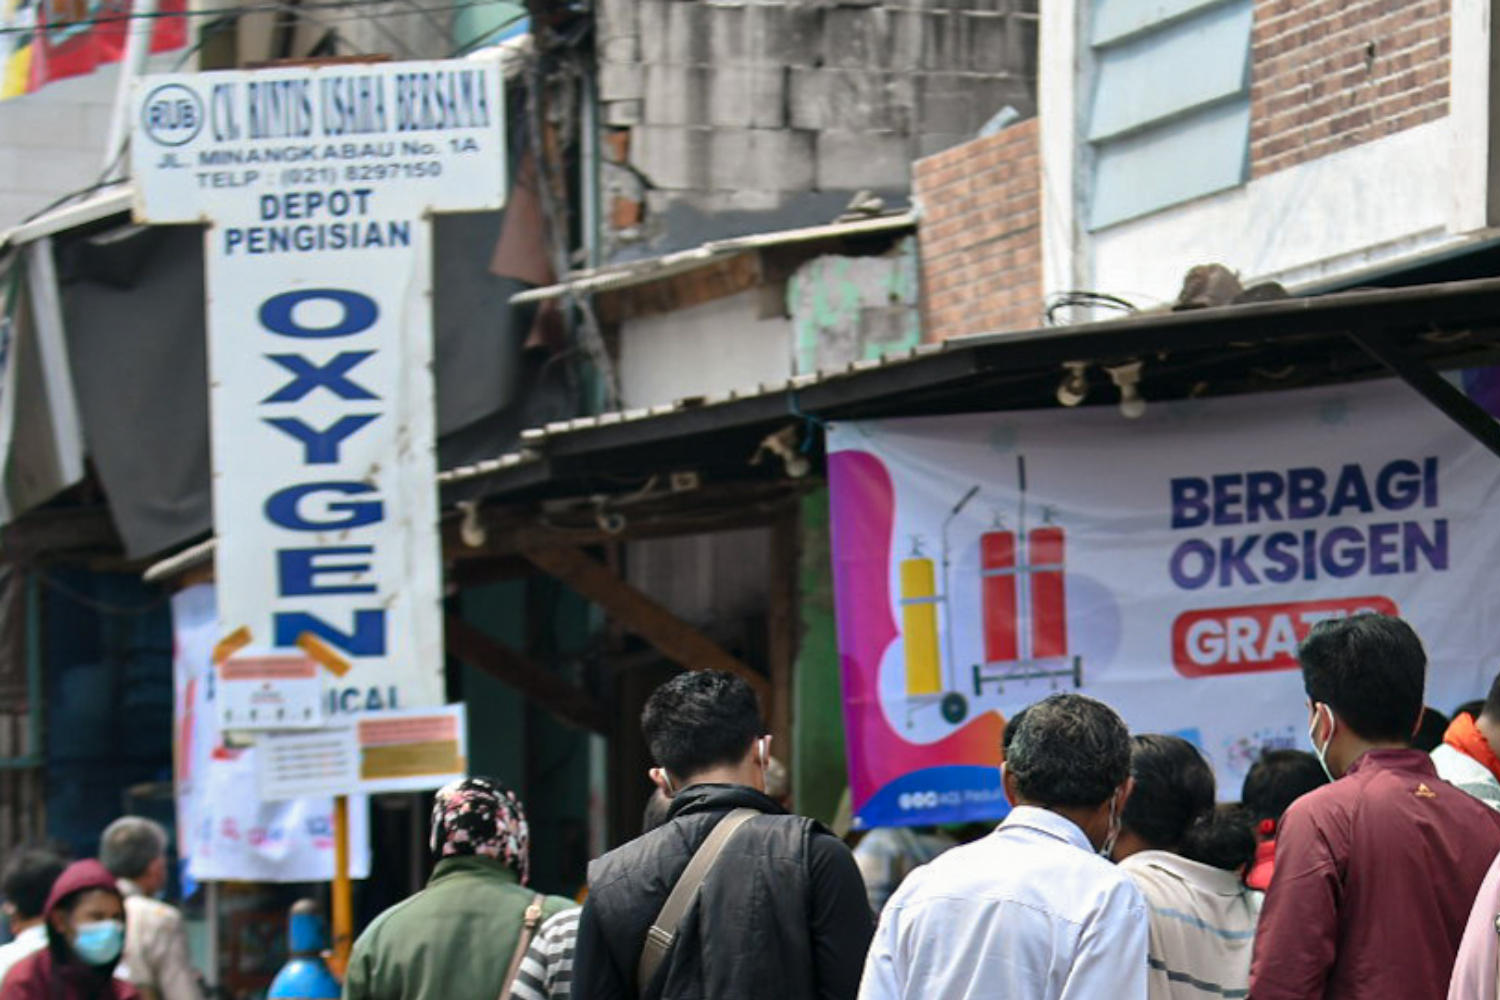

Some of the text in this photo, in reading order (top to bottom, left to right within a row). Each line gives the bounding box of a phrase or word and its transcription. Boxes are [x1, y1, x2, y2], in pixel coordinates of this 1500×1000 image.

[249, 79, 312, 138] RINTIS
[320, 75, 387, 136] USAHA
[396, 70, 490, 131] BERSAMA
[197, 171, 260, 188] TELP
[281, 167, 336, 185] (021)
[345, 161, 442, 182] 8297150
[199, 141, 395, 166] MINANGKABAU
[402, 142, 440, 156] No.
[449, 137, 479, 152] 1A
[260, 189, 374, 221] DEPOT
[225, 220, 411, 254] PENGISIAN
[258, 288, 388, 659] OXYGEN
[1170, 456, 1438, 529] BERBAGI
[1169, 518, 1449, 590] OKSIGEN
[1185, 606, 1378, 666] GRA
